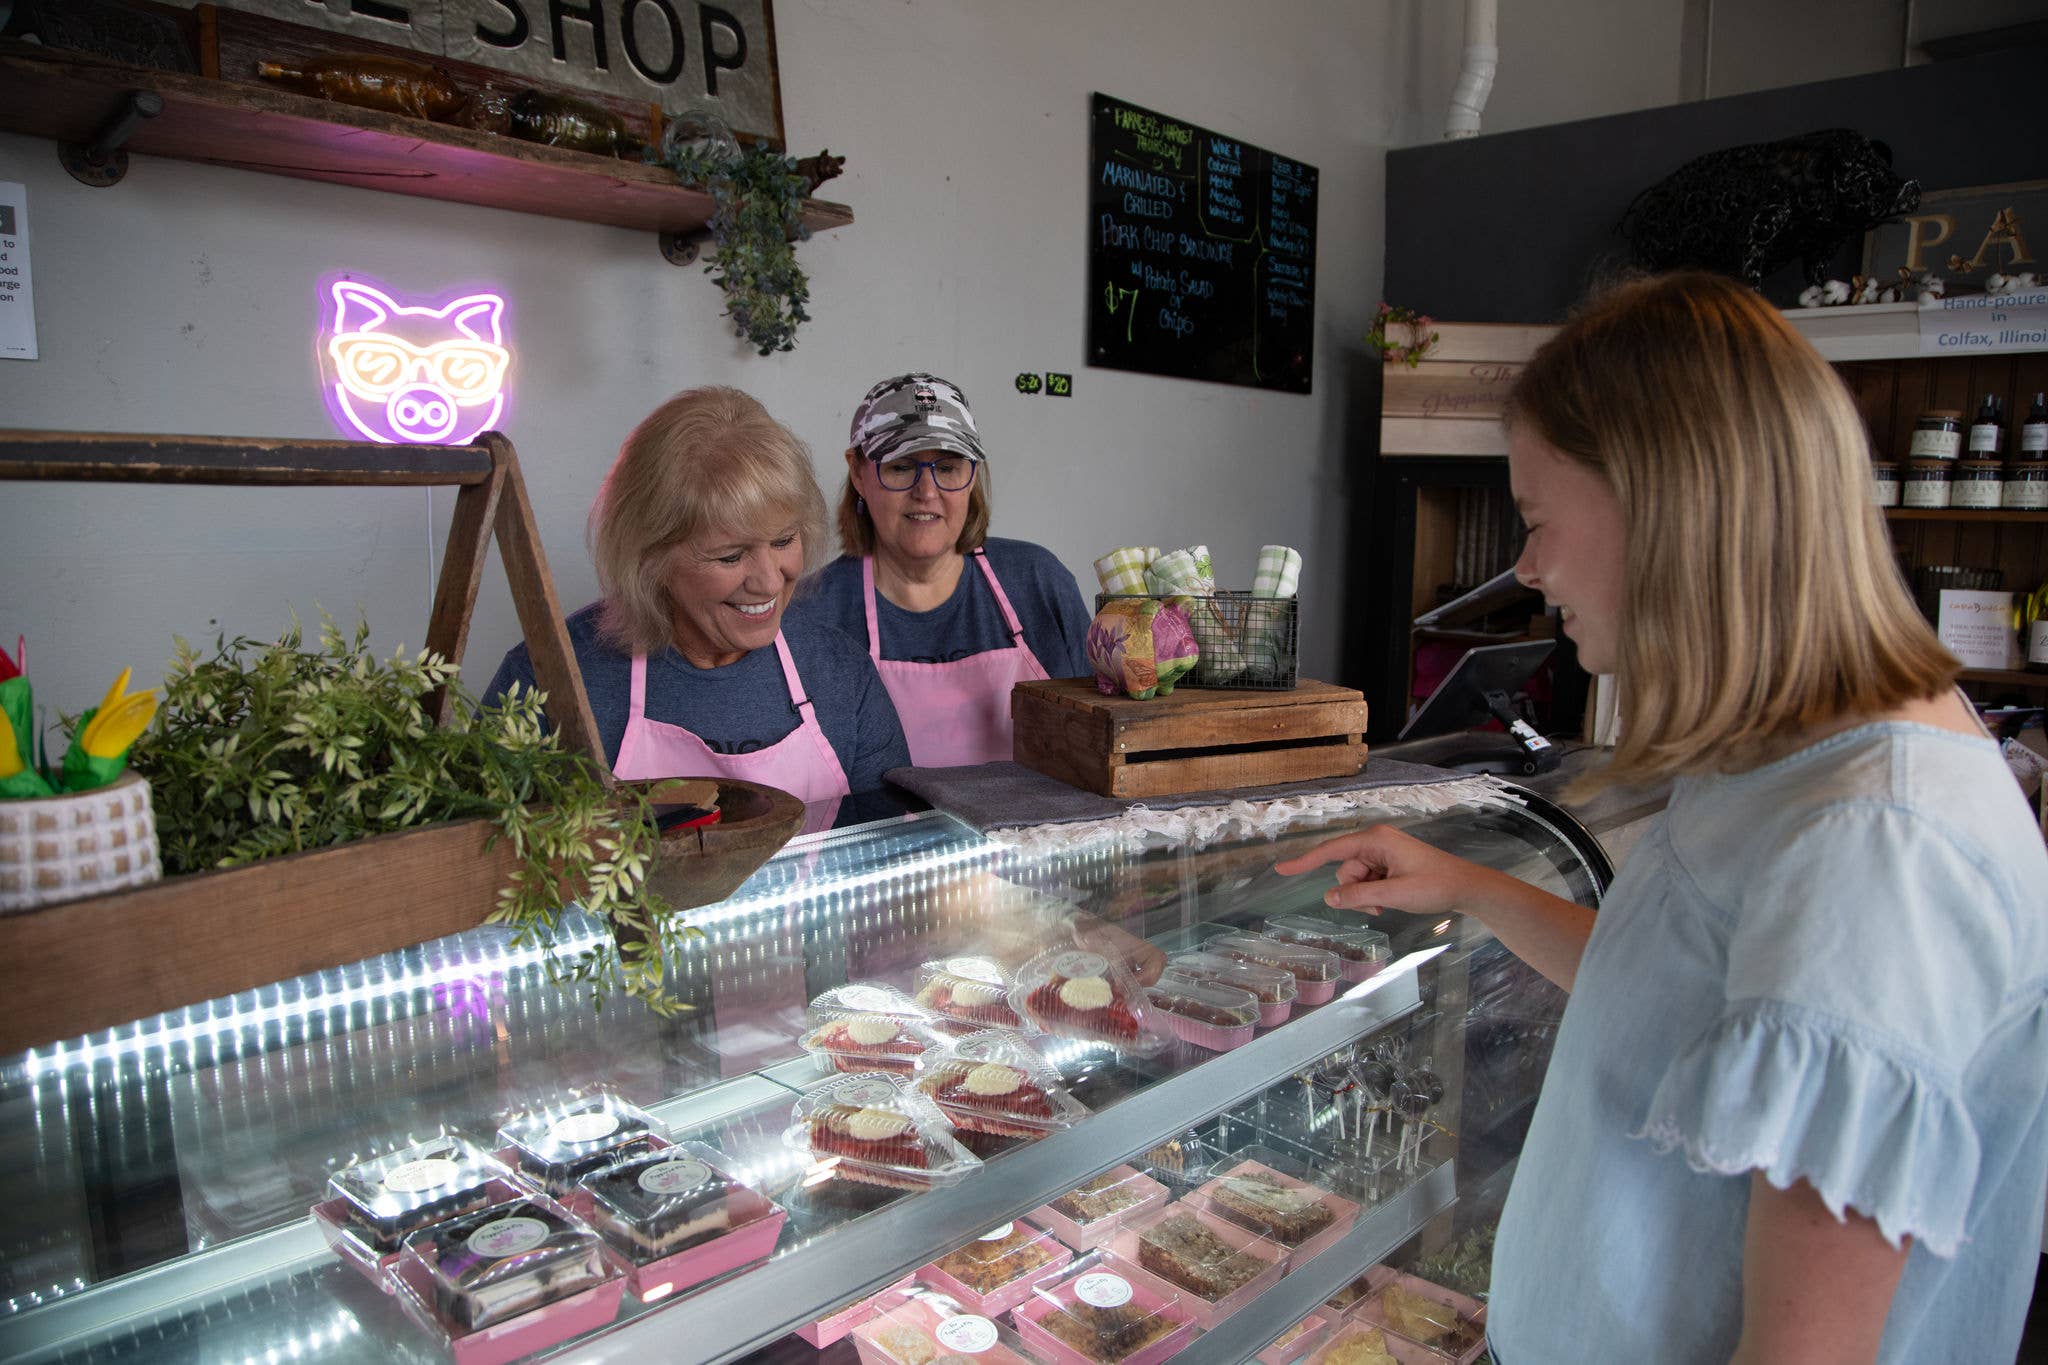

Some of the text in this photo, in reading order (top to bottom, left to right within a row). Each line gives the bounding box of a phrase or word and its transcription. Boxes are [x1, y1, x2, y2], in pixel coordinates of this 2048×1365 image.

[1102, 160, 1177, 199] MARINATED
[1123, 192, 1174, 219] GRILLED
[1102, 213, 1140, 250] PORK
[1143, 225, 1176, 254] CHOP
[3, 240, 15, 248] to
[1169, 294, 1185, 309] or
[1944, 294, 2048, 310] Hand-poure
[1991, 312, 2007, 322] in
[1938, 329, 2048, 347] Colfax, Illinoi
[1047, 373, 1070, 395] $20
